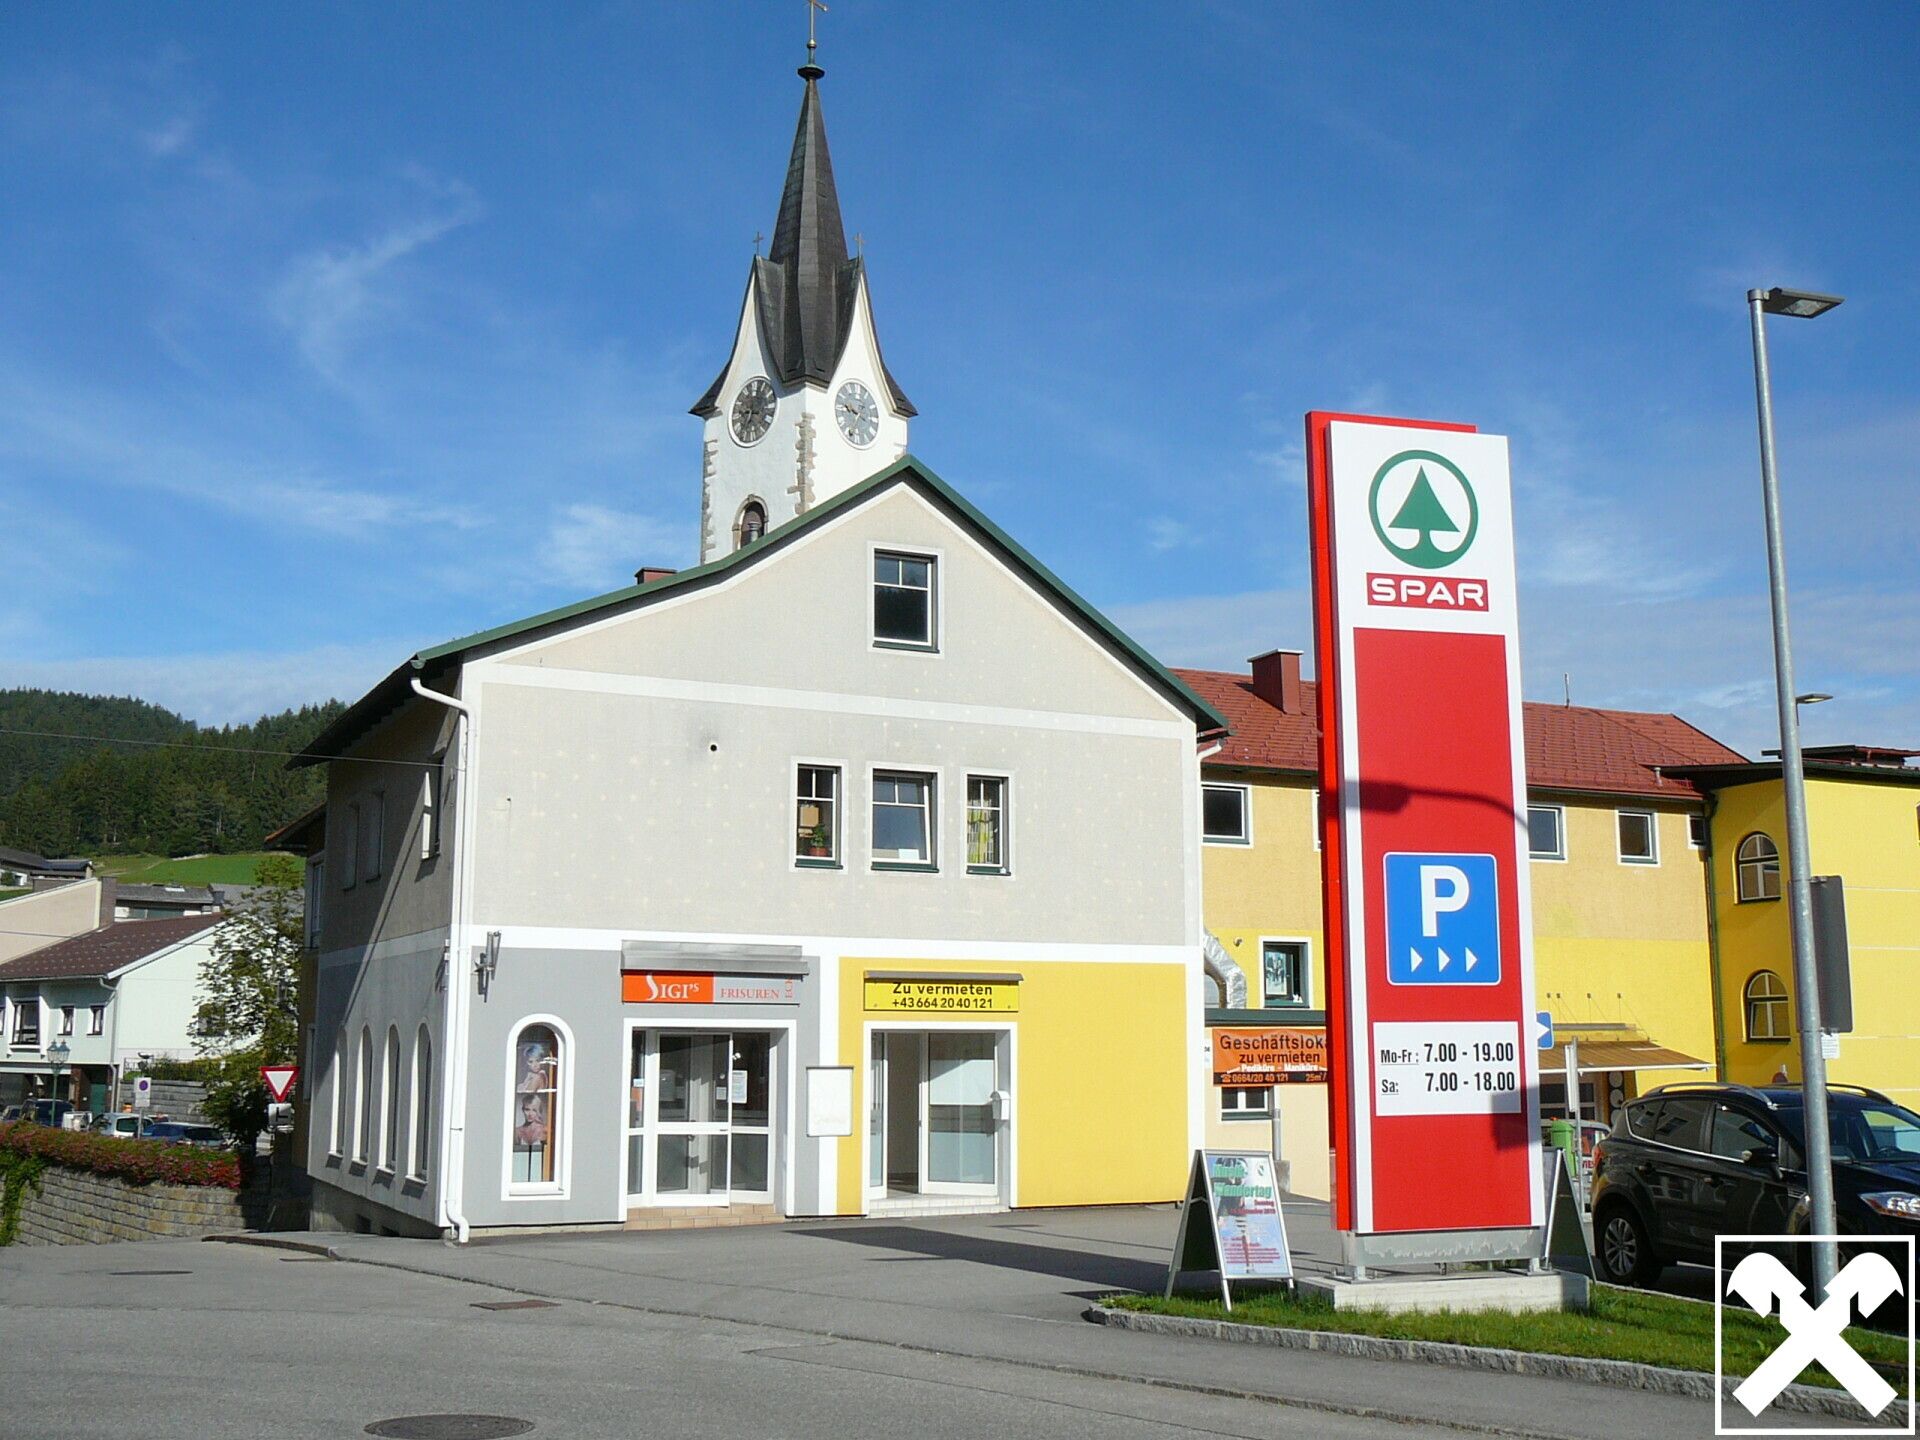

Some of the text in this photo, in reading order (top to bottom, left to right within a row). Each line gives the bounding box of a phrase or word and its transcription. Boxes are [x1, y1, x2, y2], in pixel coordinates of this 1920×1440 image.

[1371, 577, 1484, 607] SPAR
[1420, 865, 1470, 937] P
[720, 988, 780, 999] FRISUREN
[892, 982, 993, 996] Zu vermieten
[1219, 1034, 1327, 1051] Geschäftslok
[1239, 1050, 1321, 1064] zu vermieten
[1424, 1043, 1457, 1062] 7.00
[1473, 1042, 1514, 1062] 19.00
[1381, 1079, 1399, 1094] Sa:
[1425, 1072, 1458, 1092] 7.00
[1474, 1071, 1515, 1091] 18.00
